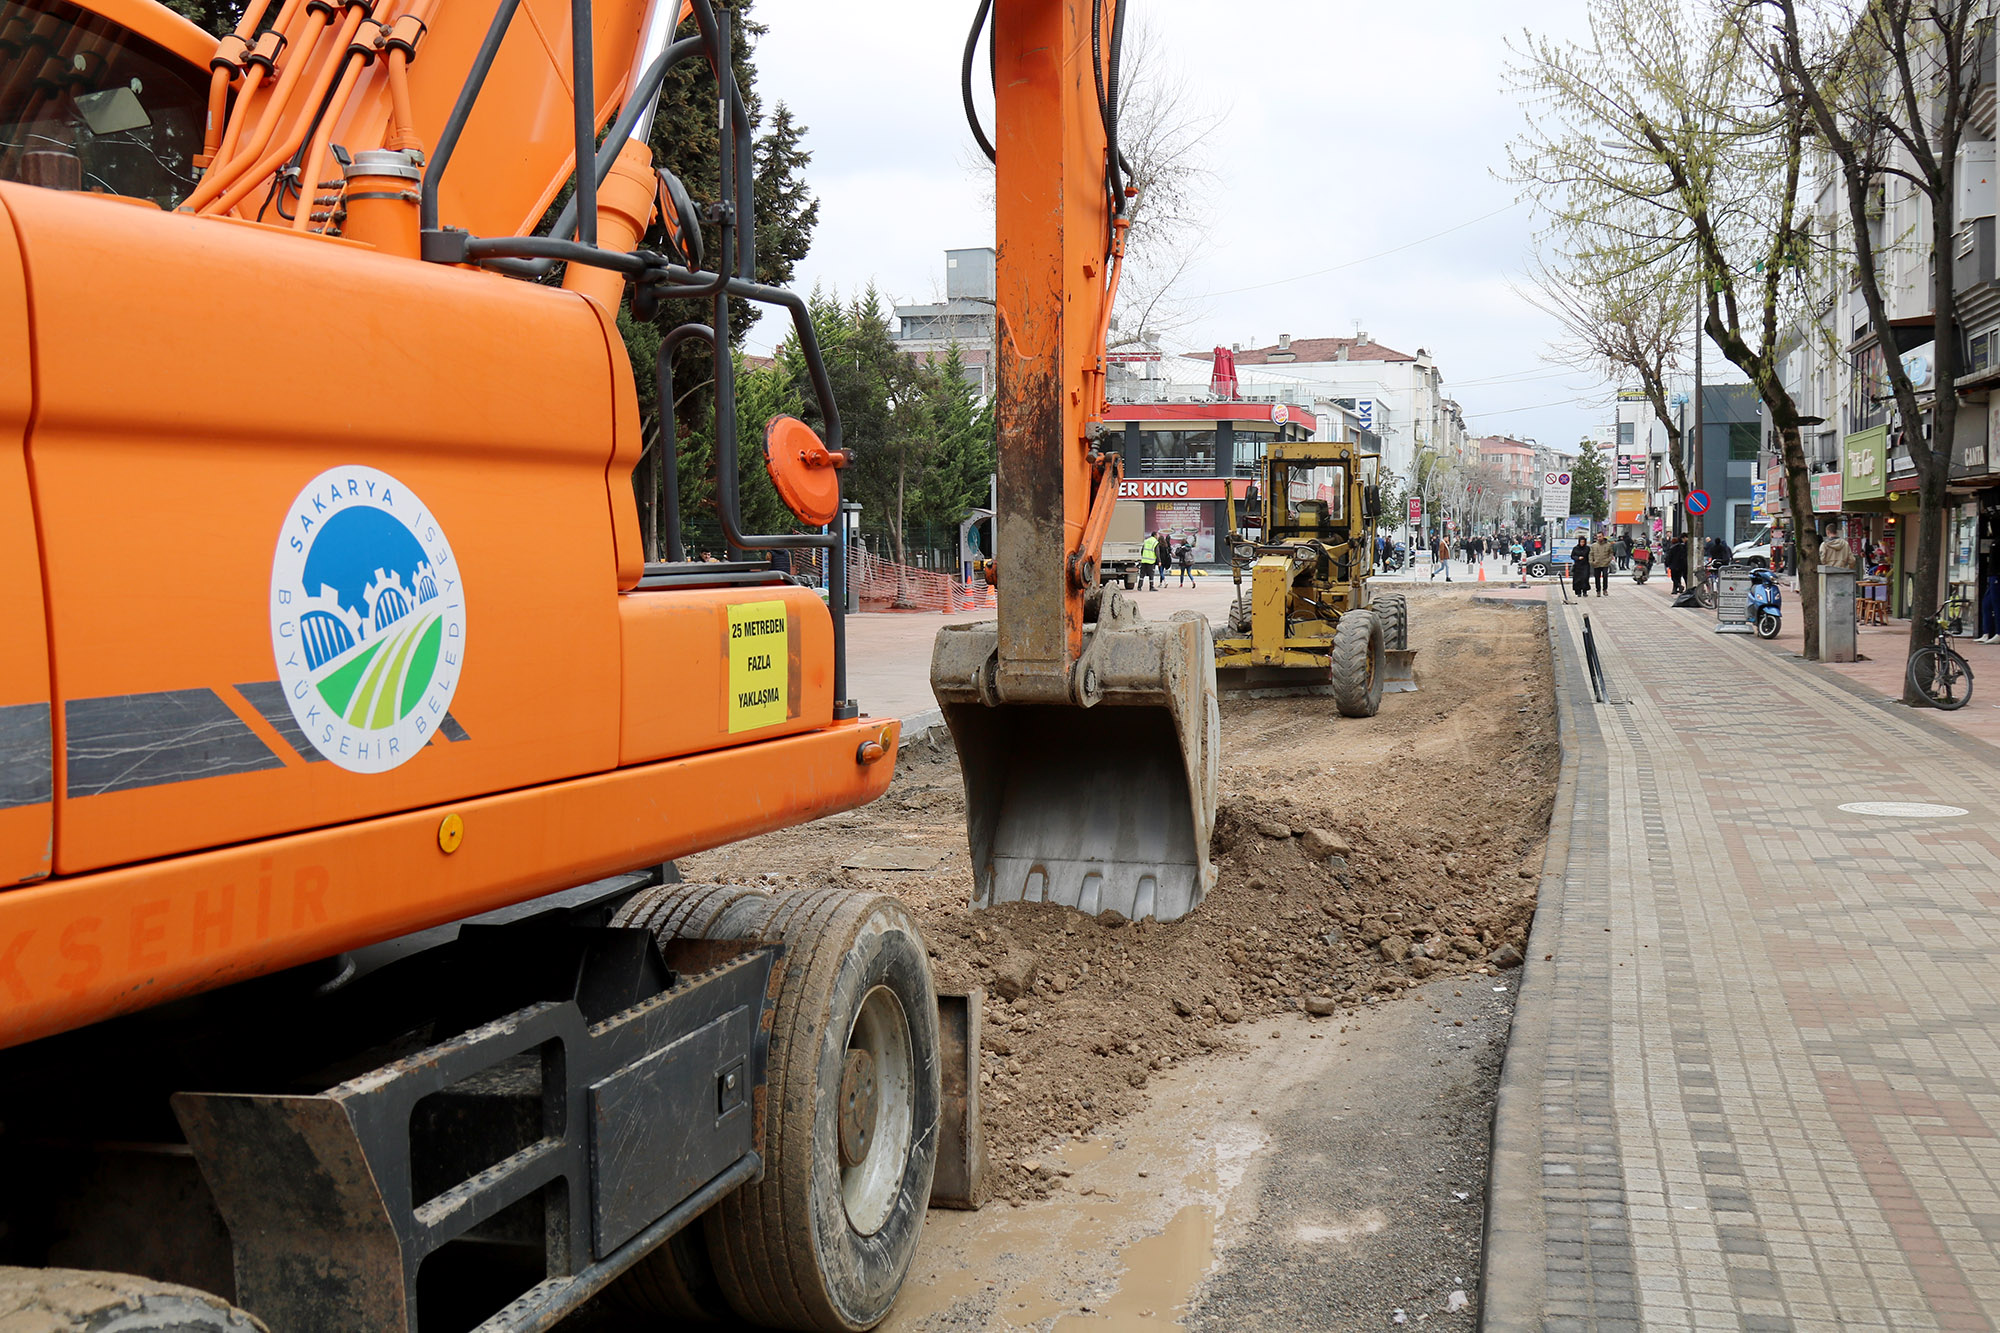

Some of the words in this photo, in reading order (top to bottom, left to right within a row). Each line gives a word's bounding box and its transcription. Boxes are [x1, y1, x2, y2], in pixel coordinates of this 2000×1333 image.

[1143, 481, 1188, 496] KING
[290, 478, 394, 553] SAKARYA
[732, 623, 742, 638] 25
[744, 618, 785, 637] METREDEN
[748, 654, 771, 672] FAZLA
[278, 589, 400, 760] BÜYÜKŞEHİR
[738, 687, 780, 708] YAKLAŞMA
